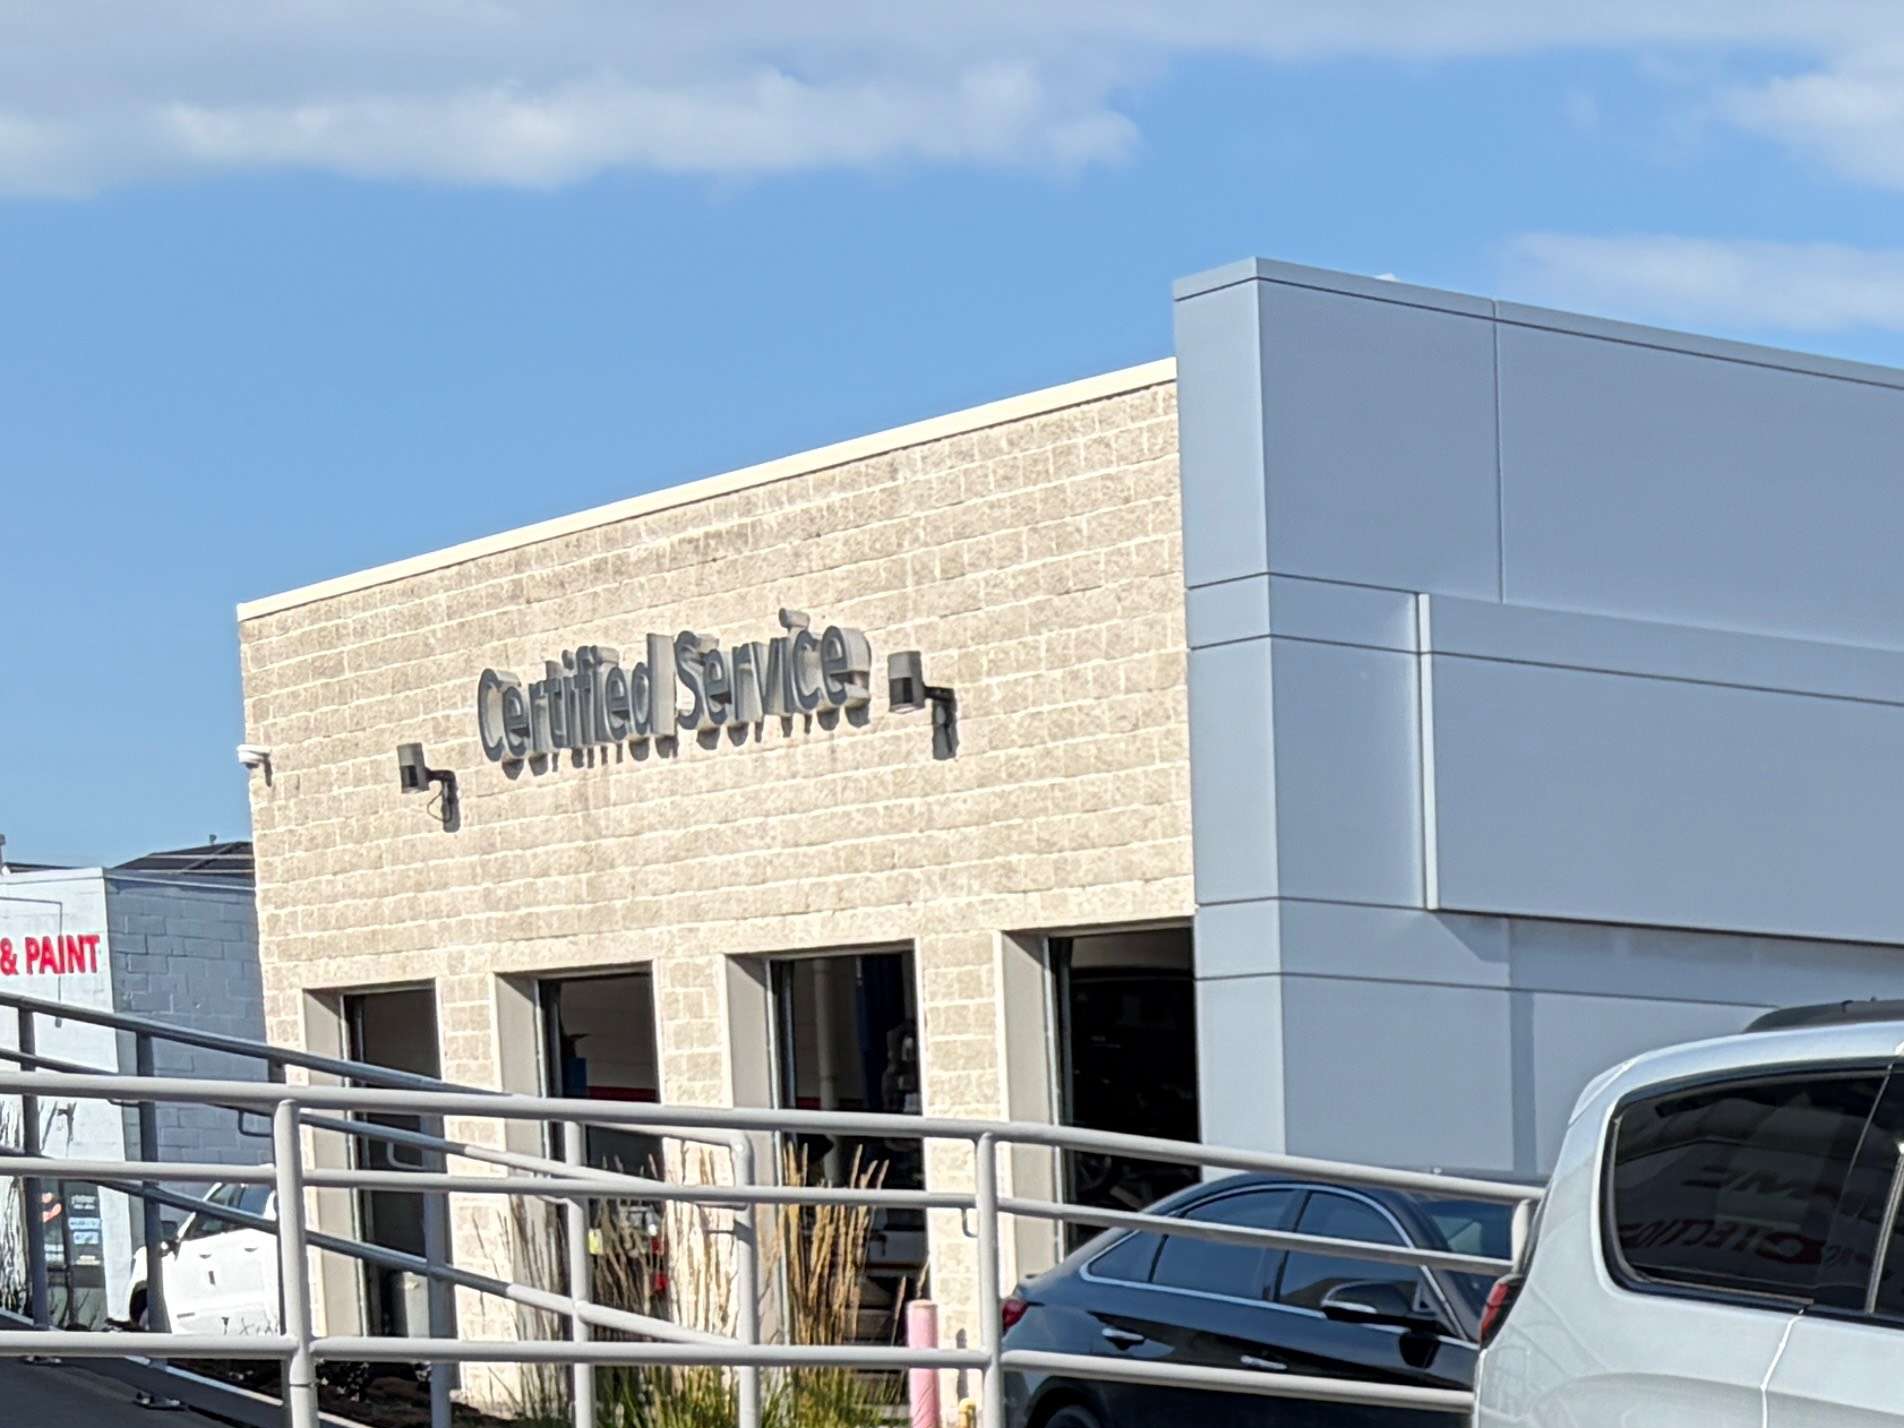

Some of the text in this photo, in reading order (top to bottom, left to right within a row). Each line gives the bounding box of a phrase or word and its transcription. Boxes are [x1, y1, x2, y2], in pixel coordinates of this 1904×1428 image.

[478, 607, 868, 763] Certified Service
[0, 933, 100, 976] & PAINT
